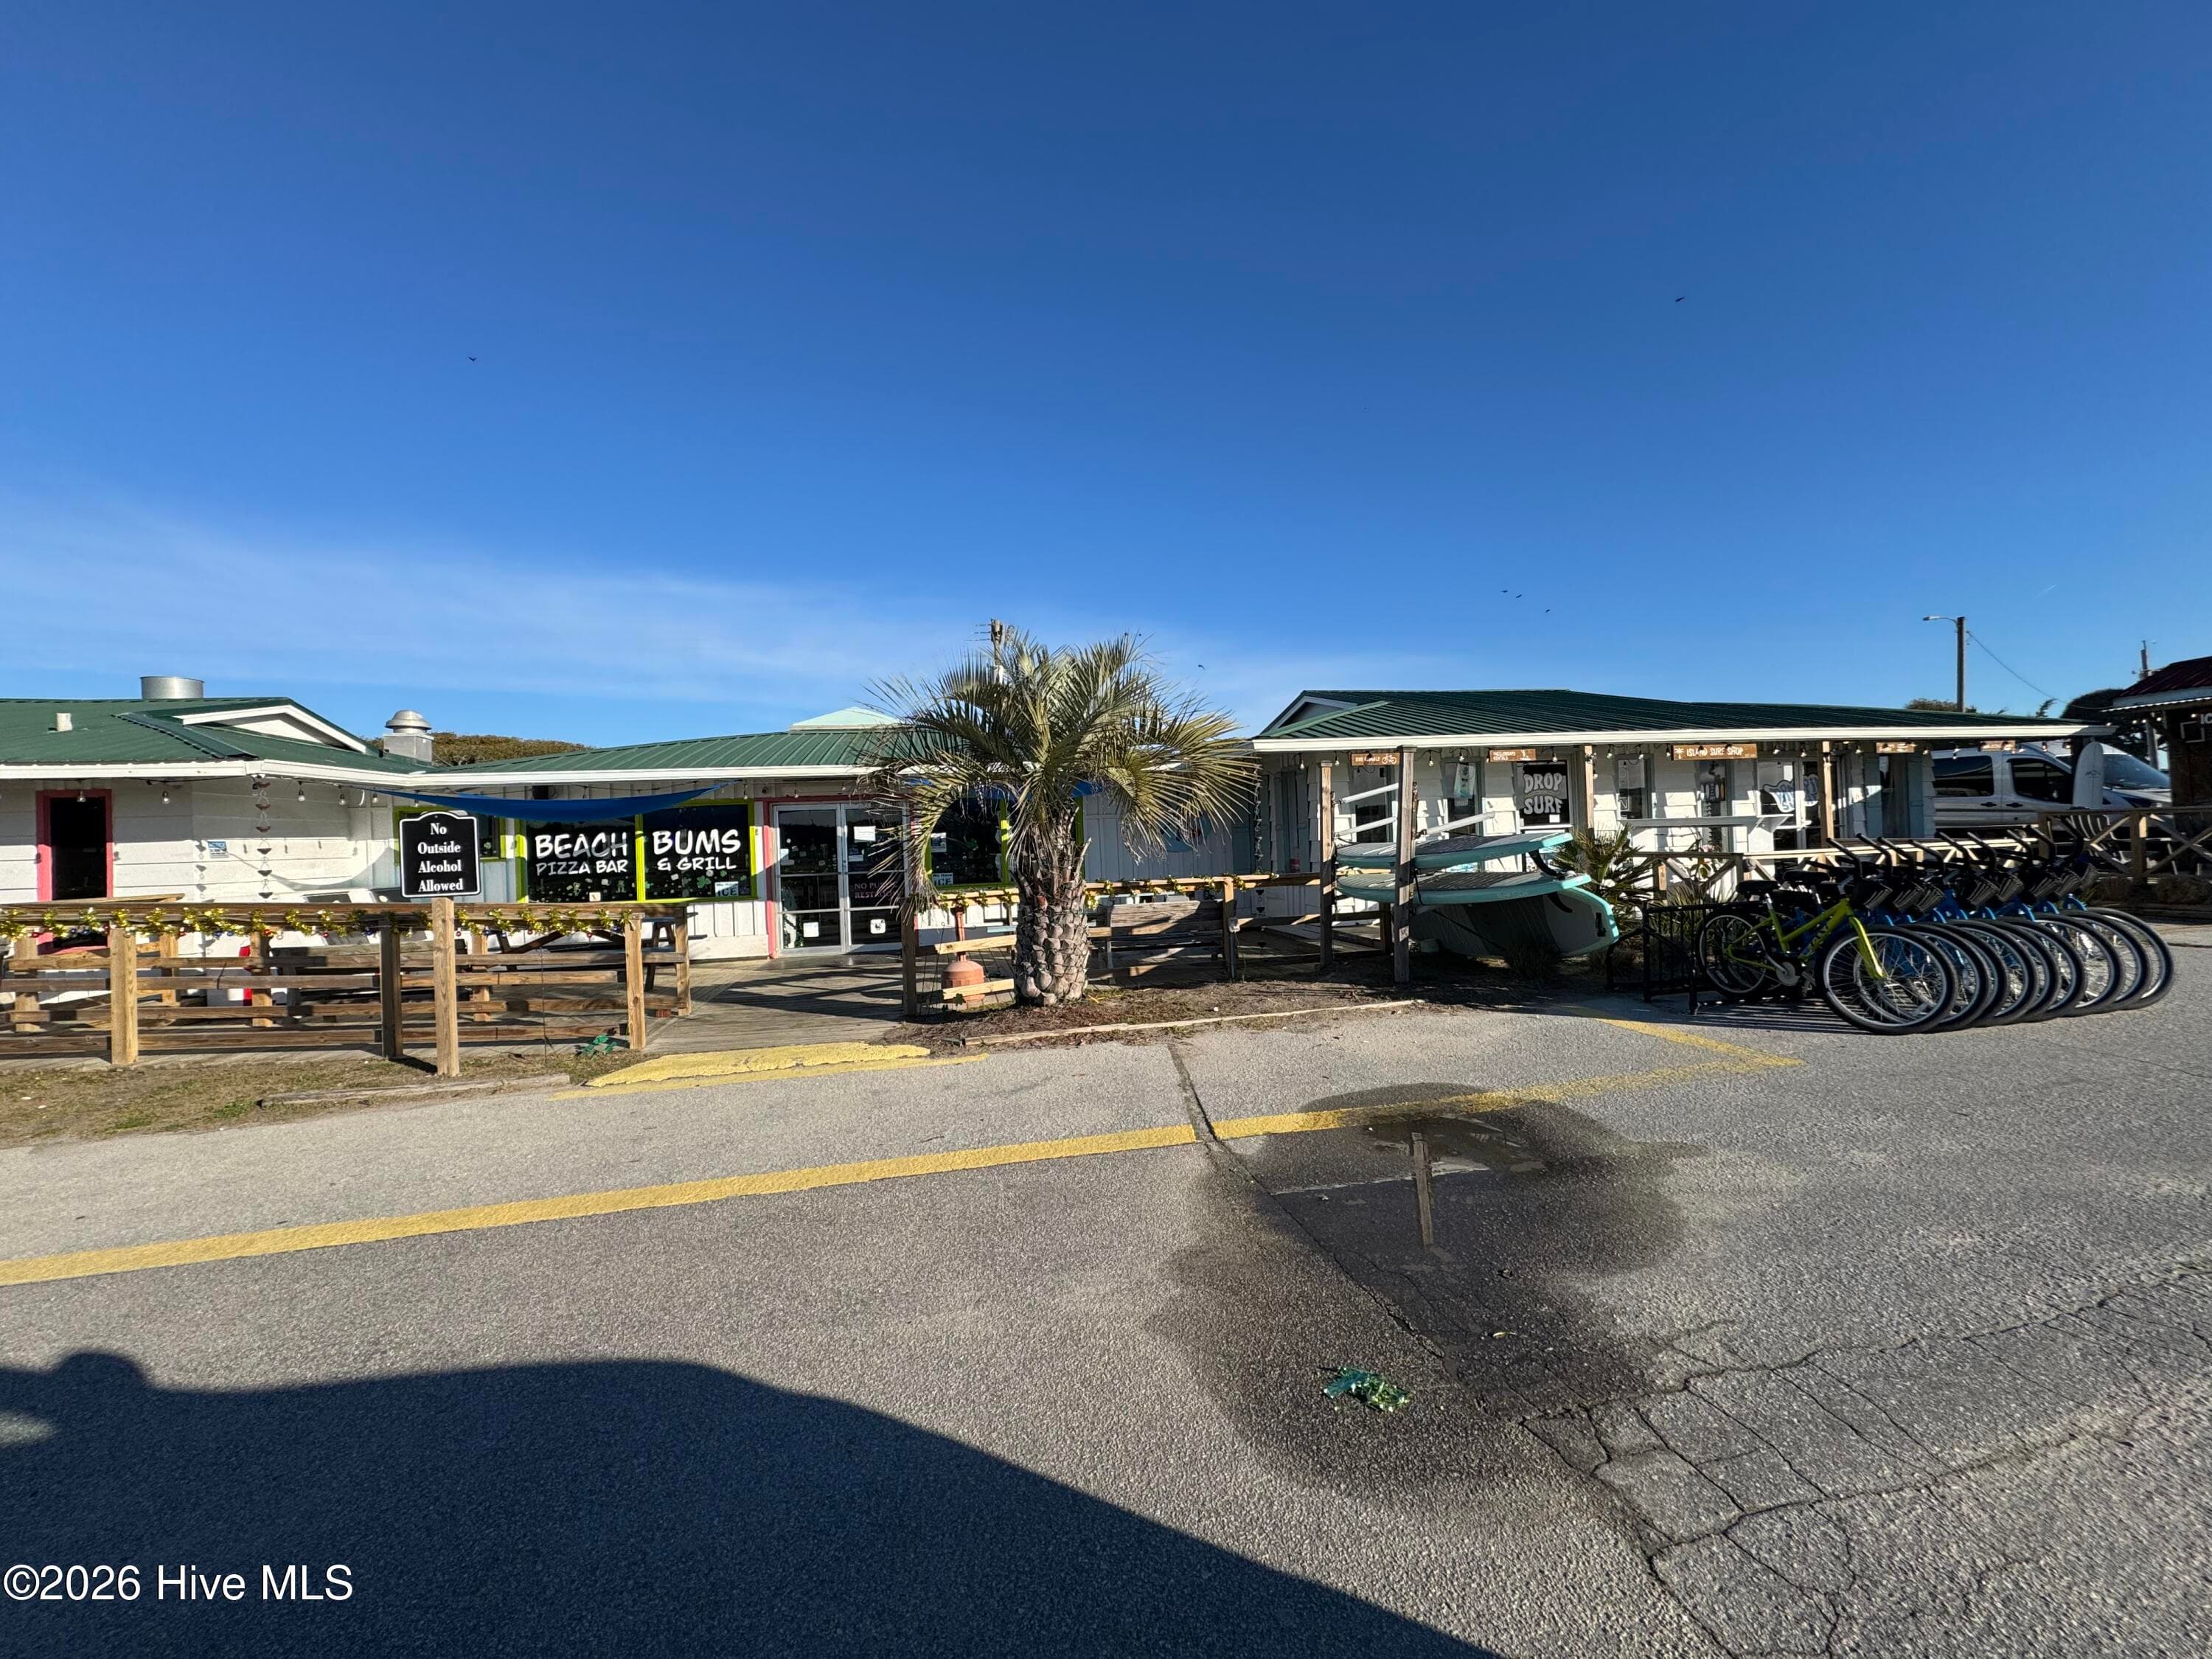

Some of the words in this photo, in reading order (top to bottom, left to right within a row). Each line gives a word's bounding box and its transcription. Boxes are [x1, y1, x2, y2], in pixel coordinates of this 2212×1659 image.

[1710, 748, 1725, 757] SURF
[1523, 773, 1562, 793] DROP
[1523, 796, 1563, 815] SURF
[431, 823, 447, 835] No
[417, 841, 462, 854] Outside
[535, 832, 627, 859] BEACH
[653, 829, 741, 855] BUMS
[418, 860, 462, 873] Alcohol
[535, 861, 591, 876] PIZZA
[596, 860, 628, 874] BAR
[657, 858, 671, 871] &
[676, 857, 737, 870] GRILL
[418, 878, 464, 892] Allowed
[717, 887, 738, 897] ICE
